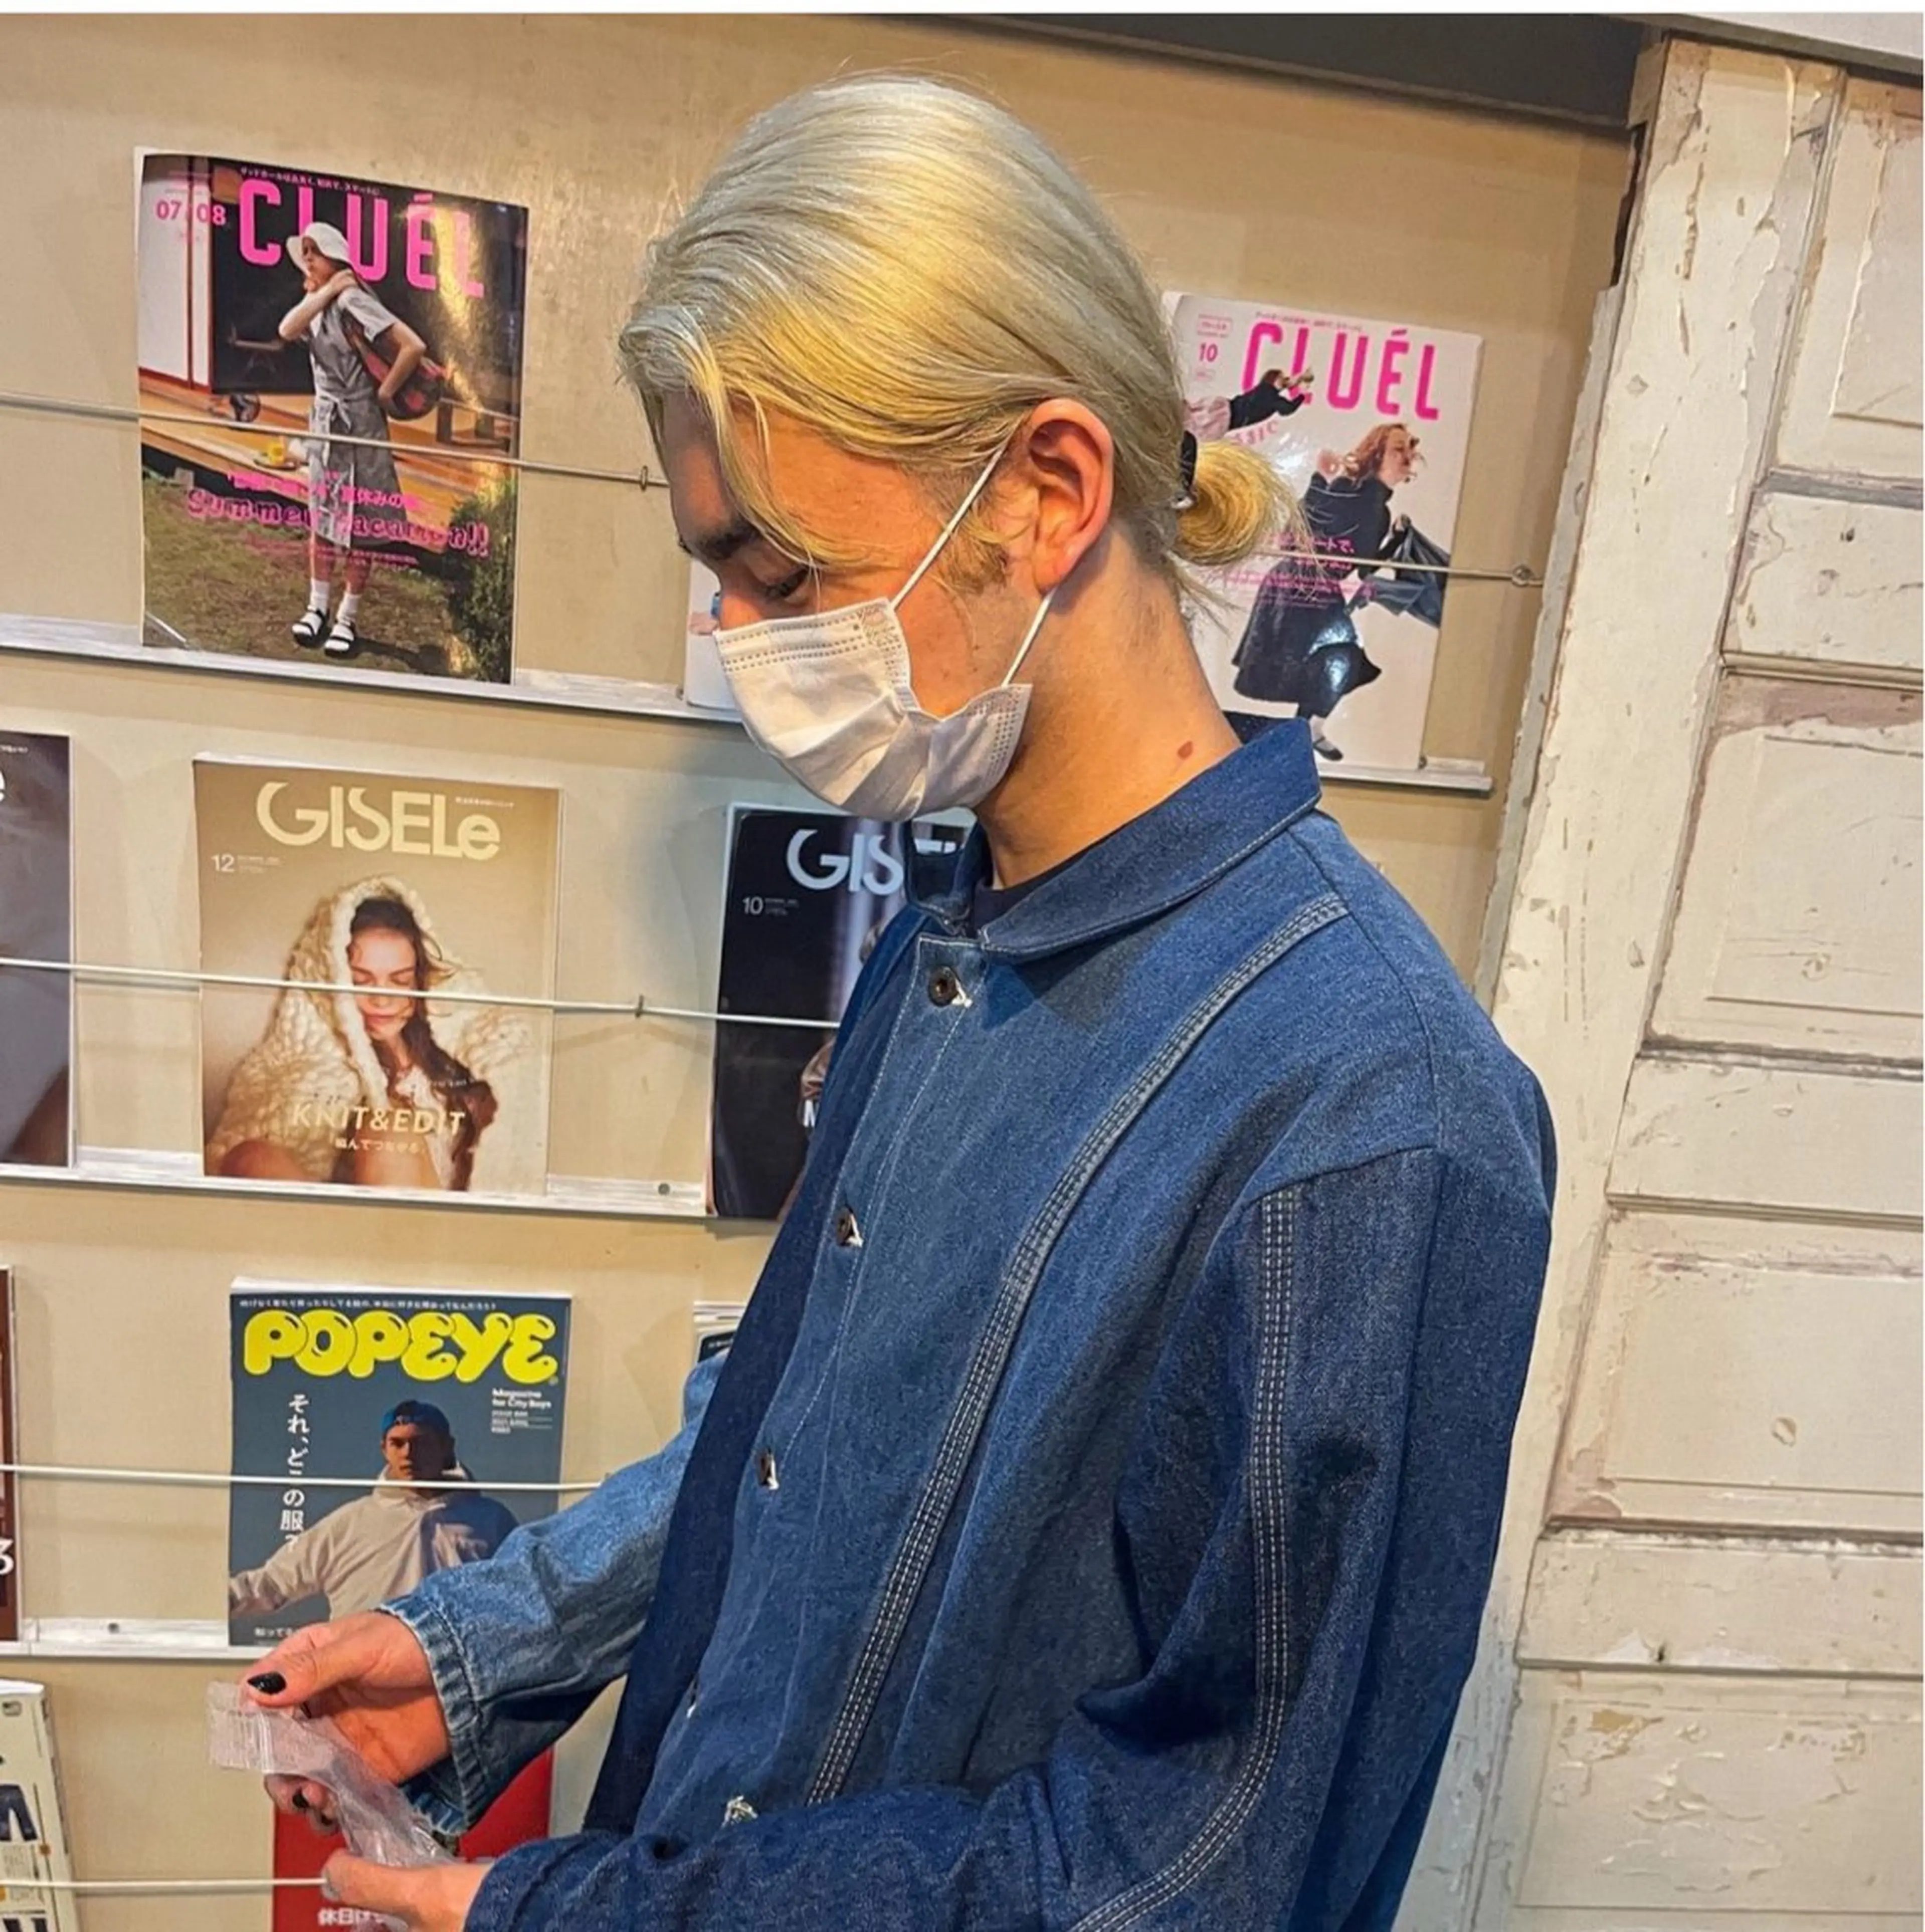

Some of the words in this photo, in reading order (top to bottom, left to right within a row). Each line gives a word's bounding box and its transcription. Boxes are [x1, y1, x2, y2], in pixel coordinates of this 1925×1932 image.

[1199, 342, 1218, 362] 10
[1242, 321, 1439, 420] CLUÉL
[256, 782, 501, 860] GISELe
[211, 852, 235, 873] 12
[742, 895, 763, 914] 10
[291, 1103, 467, 1136] KNIT&EDIT
[244, 1309, 558, 1385] POPEYE
